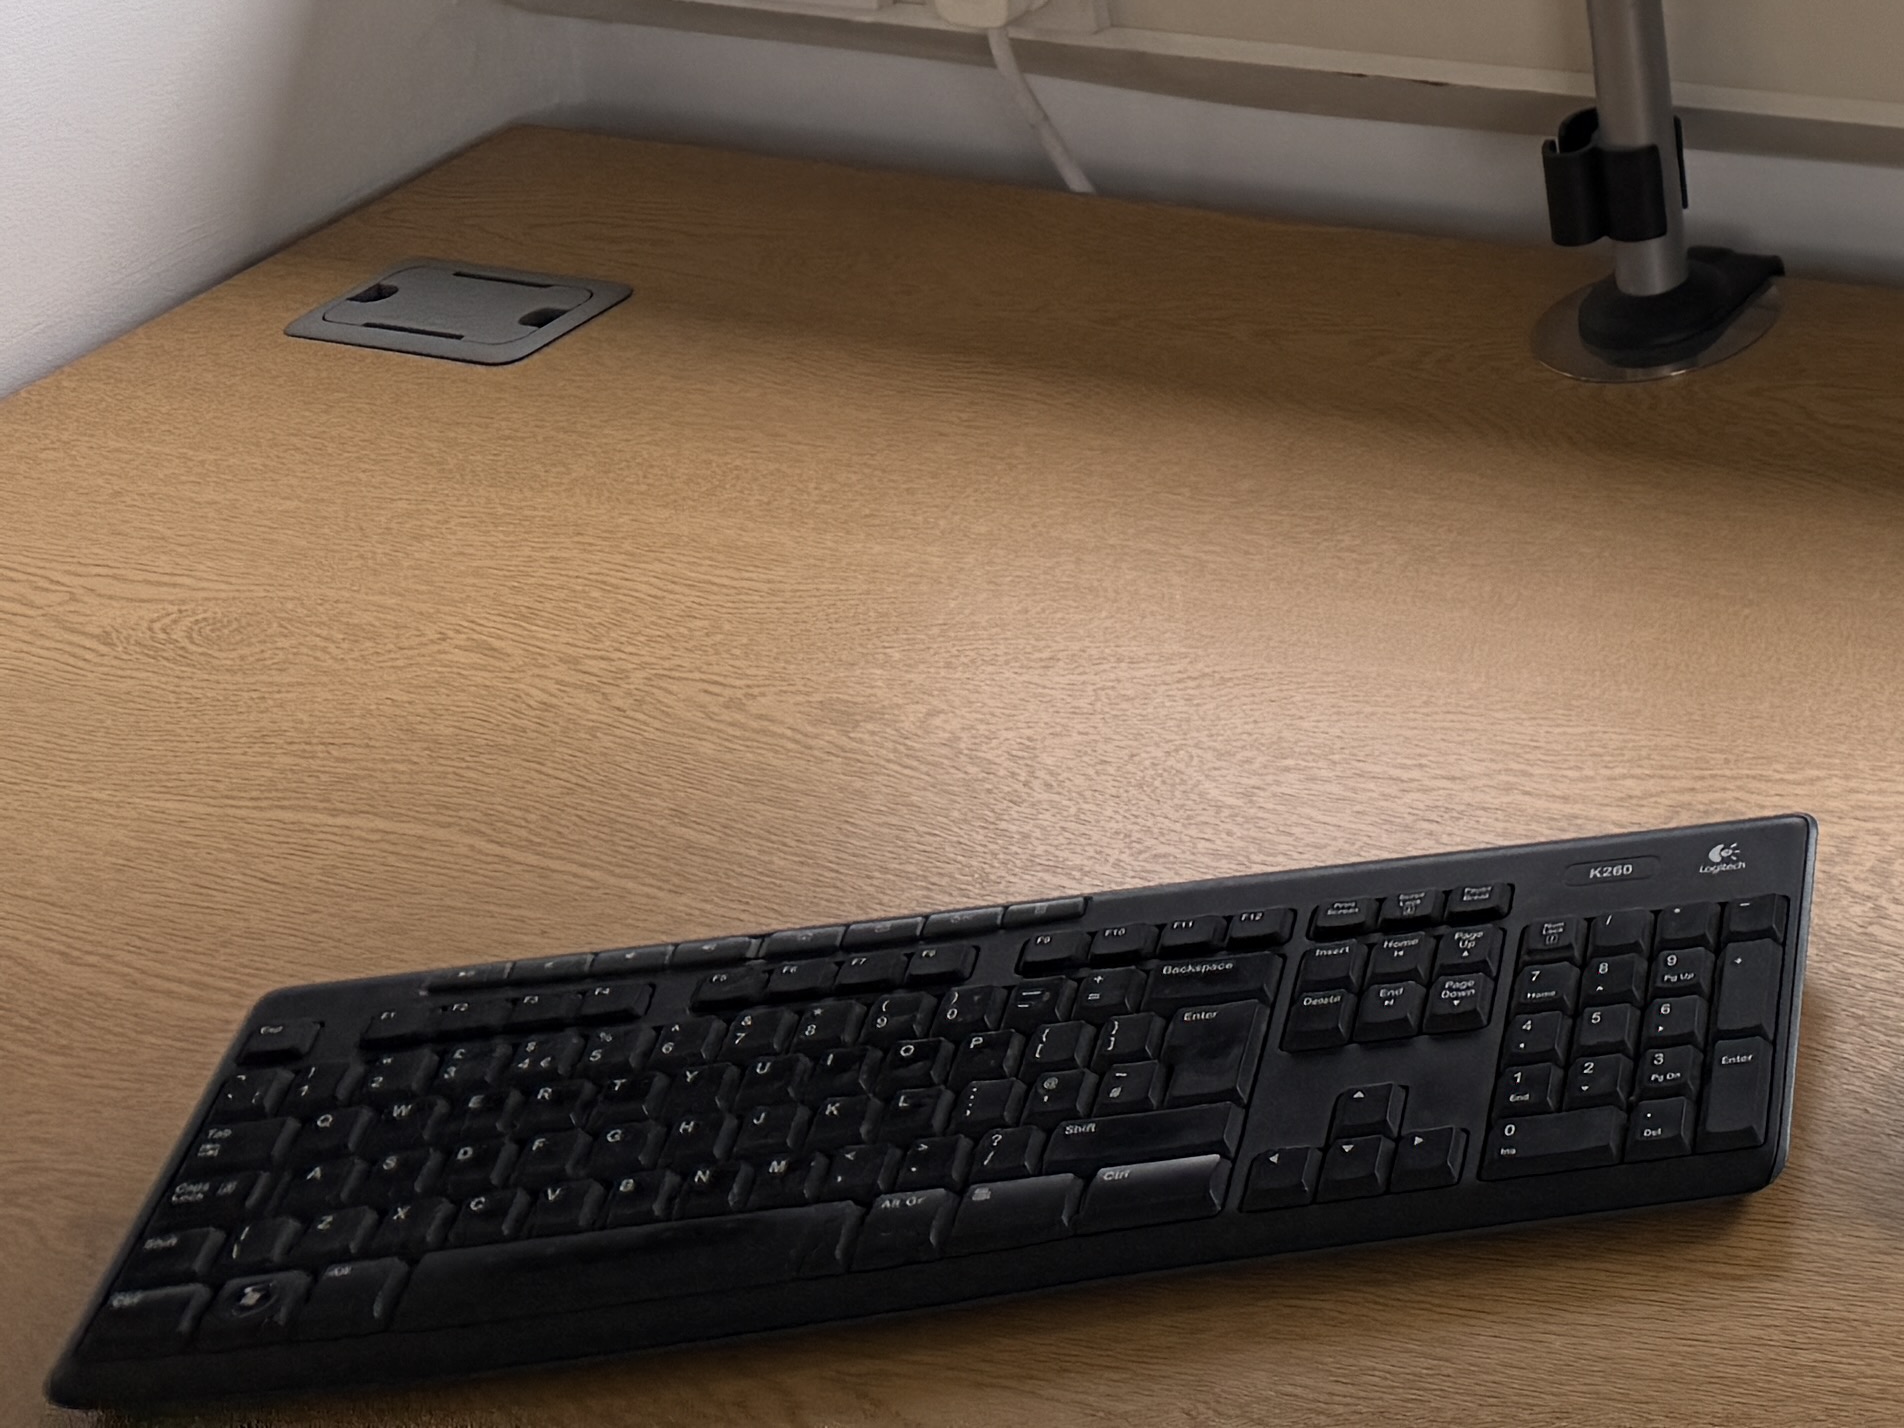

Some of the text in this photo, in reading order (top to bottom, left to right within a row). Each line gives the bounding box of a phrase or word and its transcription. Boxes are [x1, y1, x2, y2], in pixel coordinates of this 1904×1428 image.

[1589, 864, 1633, 879] K260
[1699, 861, 1746, 875] Logitech
[1241, 912, 1262, 922] F12
[1173, 920, 1193, 929] F11
[1104, 928, 1126, 937] F10
[1454, 930, 1484, 940] Page
[1383, 938, 1419, 948] Home
[1459, 939, 1476, 948] Up
[1316, 946, 1350, 956] Insert
[852, 958, 867, 966] F7
[1666, 954, 1678, 966] 9
[1162, 962, 1234, 975] Backspace
[1598, 963, 1609, 973] 8
[1531, 970, 1541, 981] 7
[1445, 980, 1475, 990] Page
[1379, 988, 1404, 997] End
[1441, 989, 1476, 998] Down
[1527, 990, 1556, 999] Home
[1660, 1004, 1671, 1014] 6
[1184, 1010, 1219, 1021] Enter
[1591, 1012, 1601, 1023] 5
[876, 1016, 888, 1028] 9
[1522, 1020, 1532, 1031] 4
[805, 1024, 816, 1036] 8
[734, 1033, 746, 1045] 7
[970, 1037, 984, 1050] P
[661, 1042, 674, 1054] 6
[900, 1045, 914, 1056] O
[589, 1050, 602, 1062] 5
[1653, 1053, 1664, 1064] 3
[1721, 1053, 1753, 1064] Enter
[756, 1062, 771, 1074] U
[1583, 1062, 1594, 1073] 2
[372, 1077, 383, 1088] 2
[686, 1070, 699, 1083] Y
[1513, 1072, 1522, 1082] 1
[612, 1079, 628, 1090] T
[537, 1087, 553, 1101] R
[468, 1095, 484, 1108] E
[898, 1096, 910, 1107] L
[392, 1103, 412, 1117] W
[826, 1103, 840, 1115] K
[317, 1114, 332, 1128] Q
[753, 1113, 766, 1125] J
[679, 1121, 695, 1134] H
[1064, 1123, 1097, 1135] Shift
[1504, 1124, 1516, 1136] 0
[606, 1130, 624, 1143] G
[532, 1138, 547, 1151] F
[457, 1146, 473, 1160] D
[382, 1156, 398, 1171] S
[769, 1160, 790, 1173] M
[306, 1167, 322, 1180] A
[694, 1170, 711, 1183] N
[619, 1178, 635, 1192] B
[547, 1188, 562, 1202] V
[471, 1196, 486, 1211] C
[881, 1197, 900, 1208] Alt
[392, 1206, 410, 1220] X
[318, 1215, 333, 1230] Z
